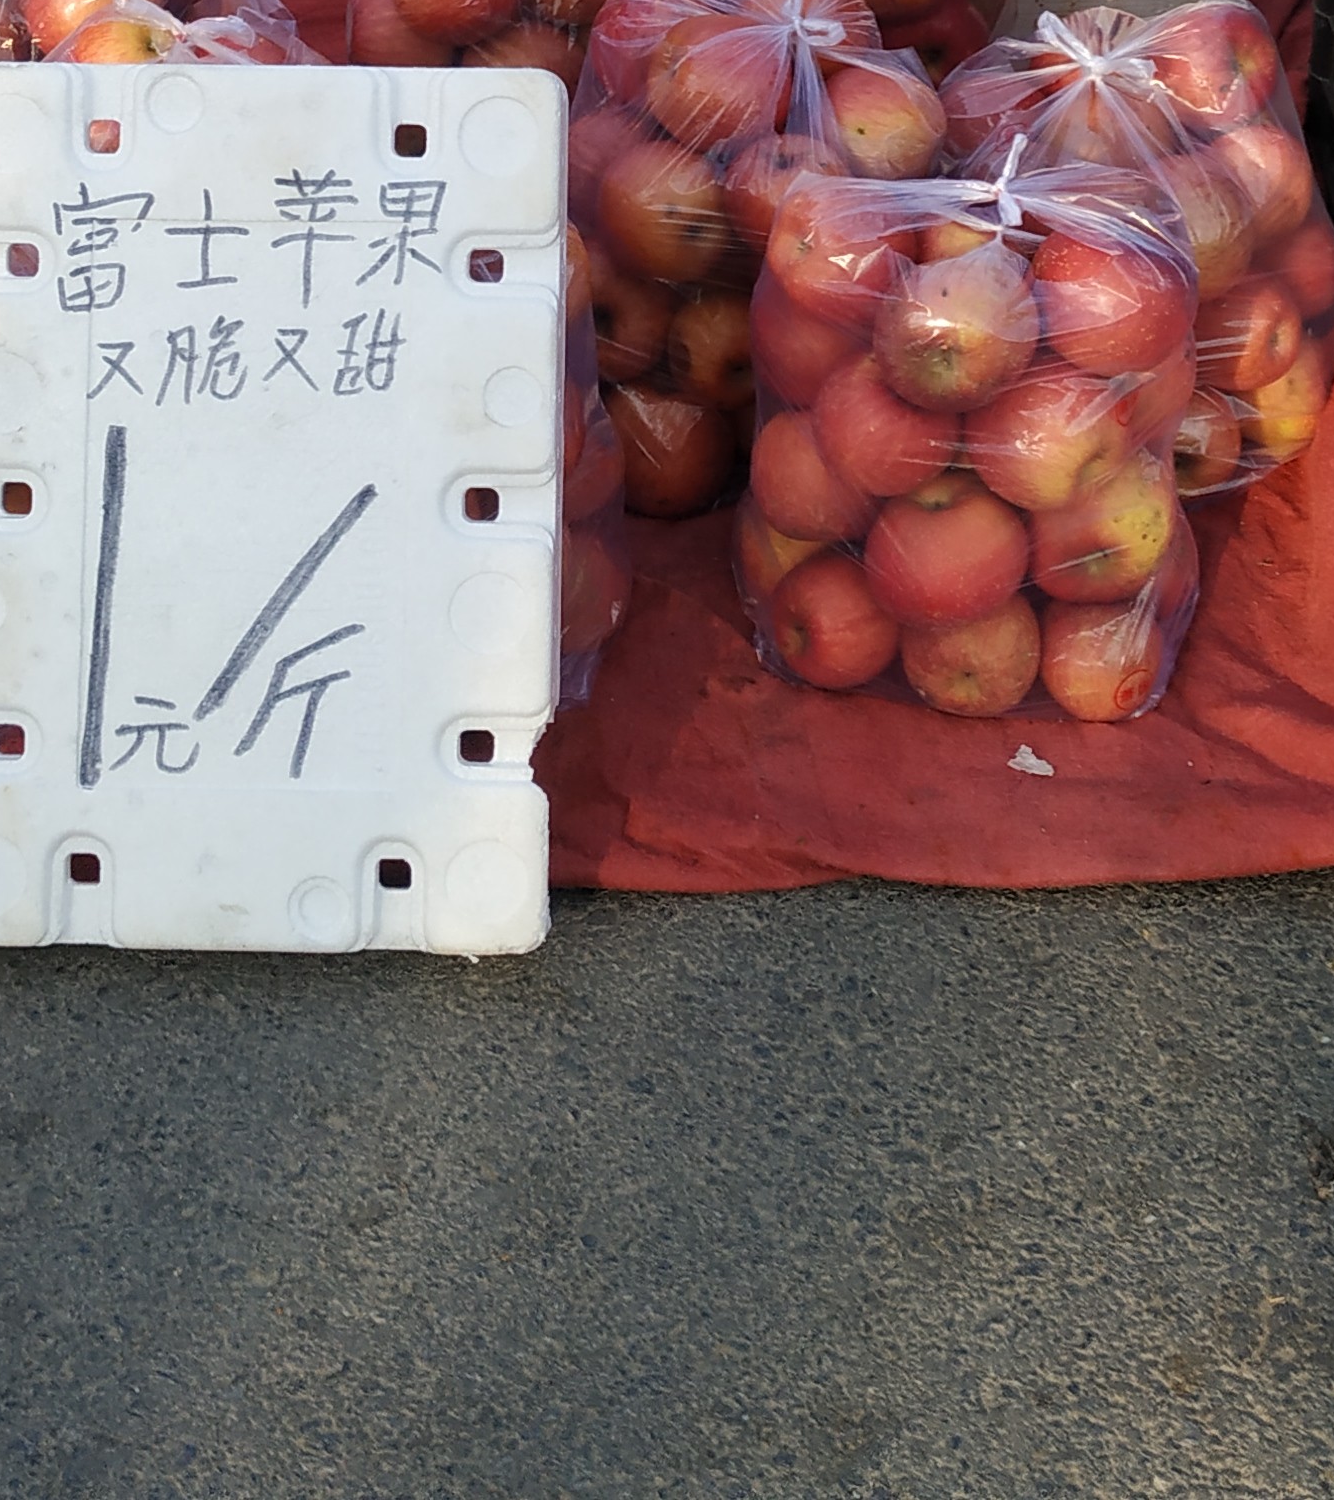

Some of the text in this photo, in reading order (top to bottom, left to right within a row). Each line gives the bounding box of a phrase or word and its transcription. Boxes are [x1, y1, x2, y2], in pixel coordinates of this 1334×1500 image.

[52, 167, 447, 313] 富士苹果
[87, 308, 407, 407] 又脆又甜
